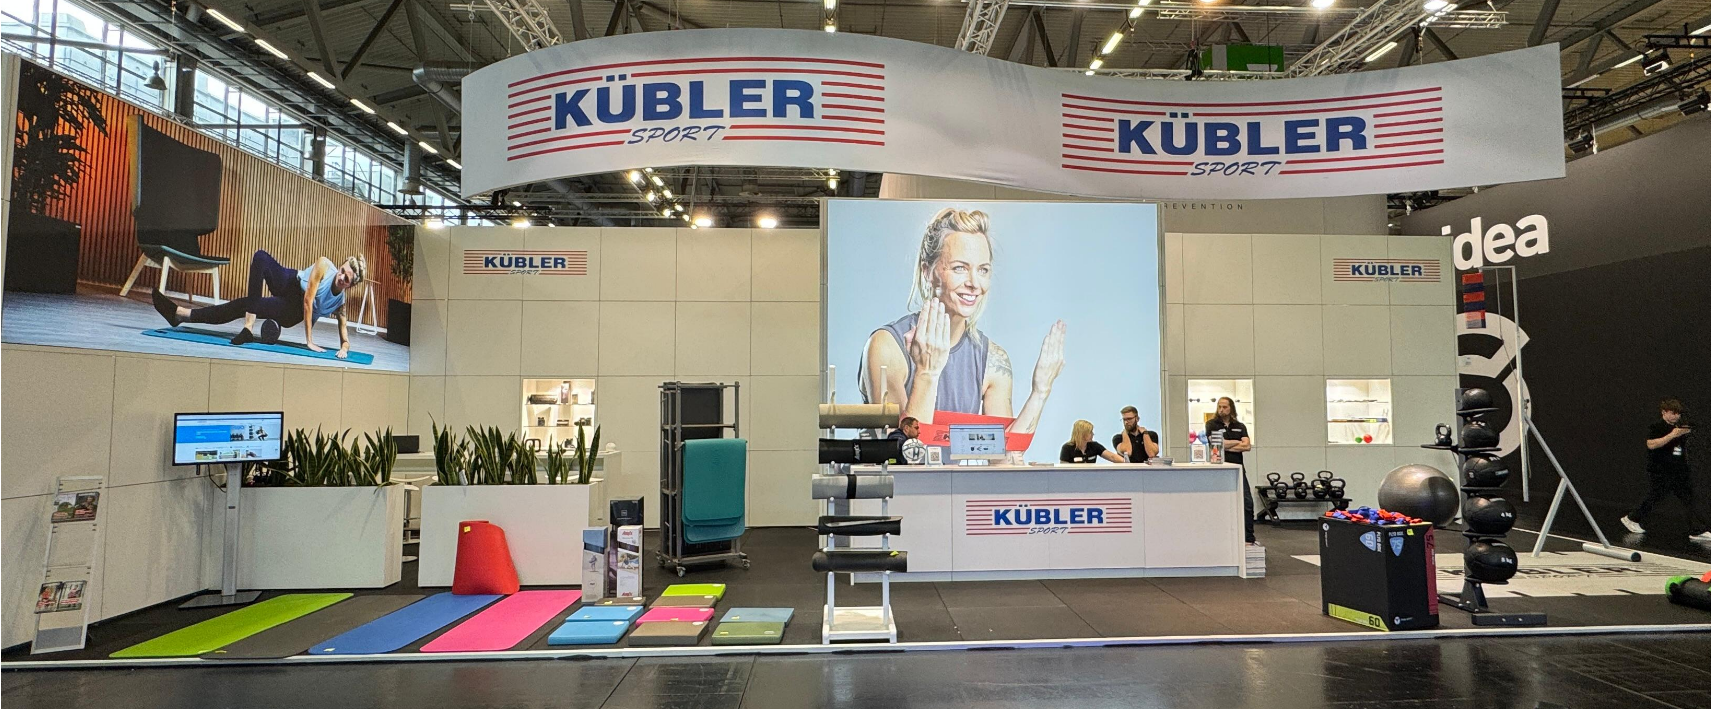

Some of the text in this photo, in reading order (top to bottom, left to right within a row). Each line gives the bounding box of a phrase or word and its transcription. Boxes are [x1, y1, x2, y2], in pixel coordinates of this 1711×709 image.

[555, 74, 815, 131] KÜBLER
[627, 125, 726, 145] SPORT
[1118, 112, 1368, 155] KÜBLER
[1190, 161, 1282, 176] SPORT
[1441, 214, 1550, 271] dea
[484, 253, 566, 269] KÜBLER
[1351, 262, 1423, 276] KÜBLER
[994, 504, 1104, 526] KÜBLER
[1028, 526, 1069, 535] SPORT
[1366, 534, 1373, 547] 60
[1426, 534, 1434, 548] 75
[1438, 567, 1643, 576] KBLER
[1369, 616, 1380, 627] 60
